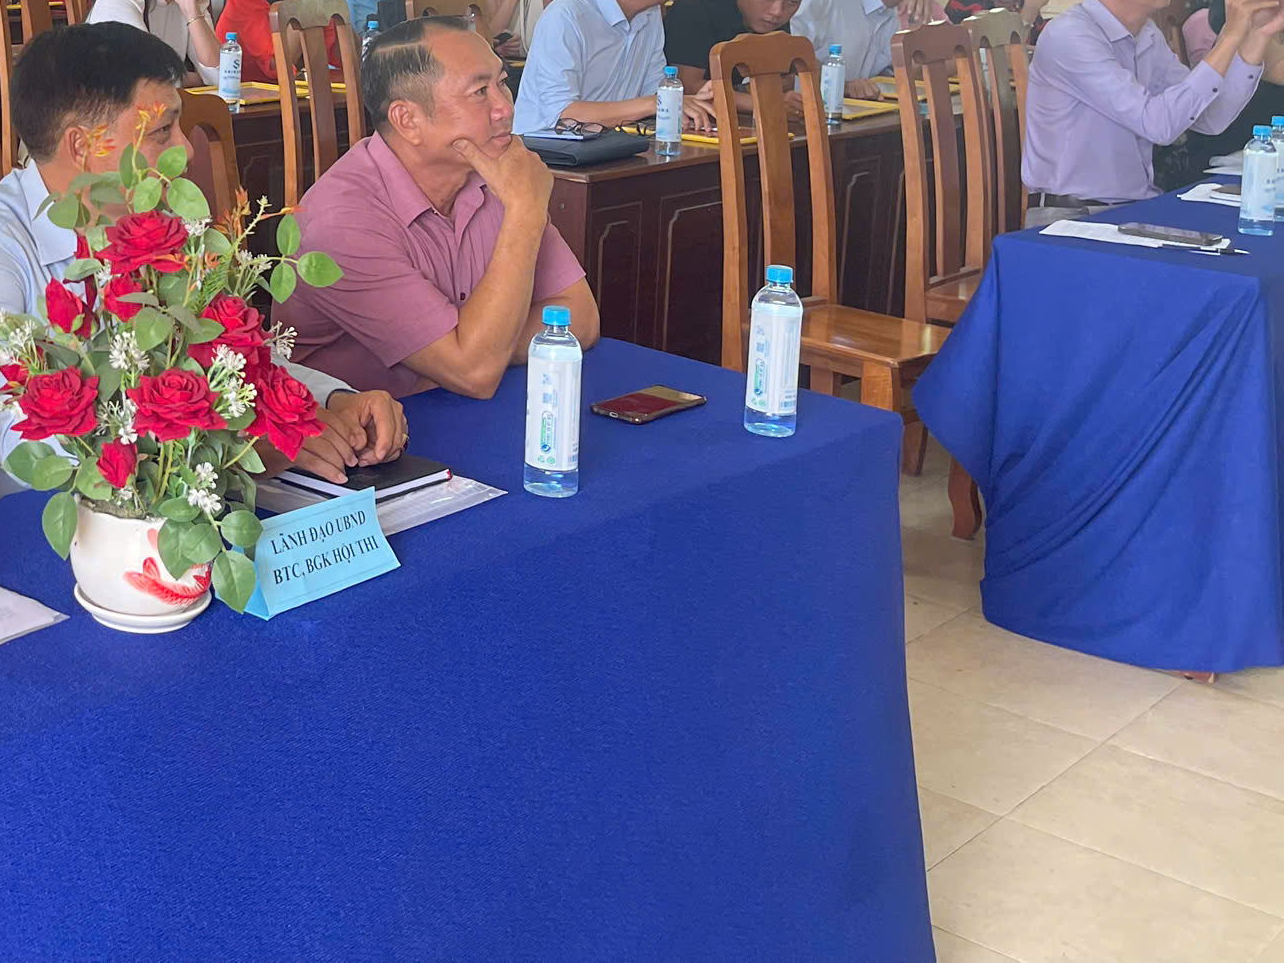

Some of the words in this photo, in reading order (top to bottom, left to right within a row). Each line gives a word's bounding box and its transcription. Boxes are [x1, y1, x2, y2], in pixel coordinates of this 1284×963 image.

[270, 529, 308, 555] LÃNH
[308, 521, 334, 543] ĐẠO
[335, 510, 366, 533] UBND
[273, 563, 306, 585] BTC,
[305, 552, 332, 574] BGK
[332, 543, 356, 564] HỘI
[355, 535, 379, 555] THI
